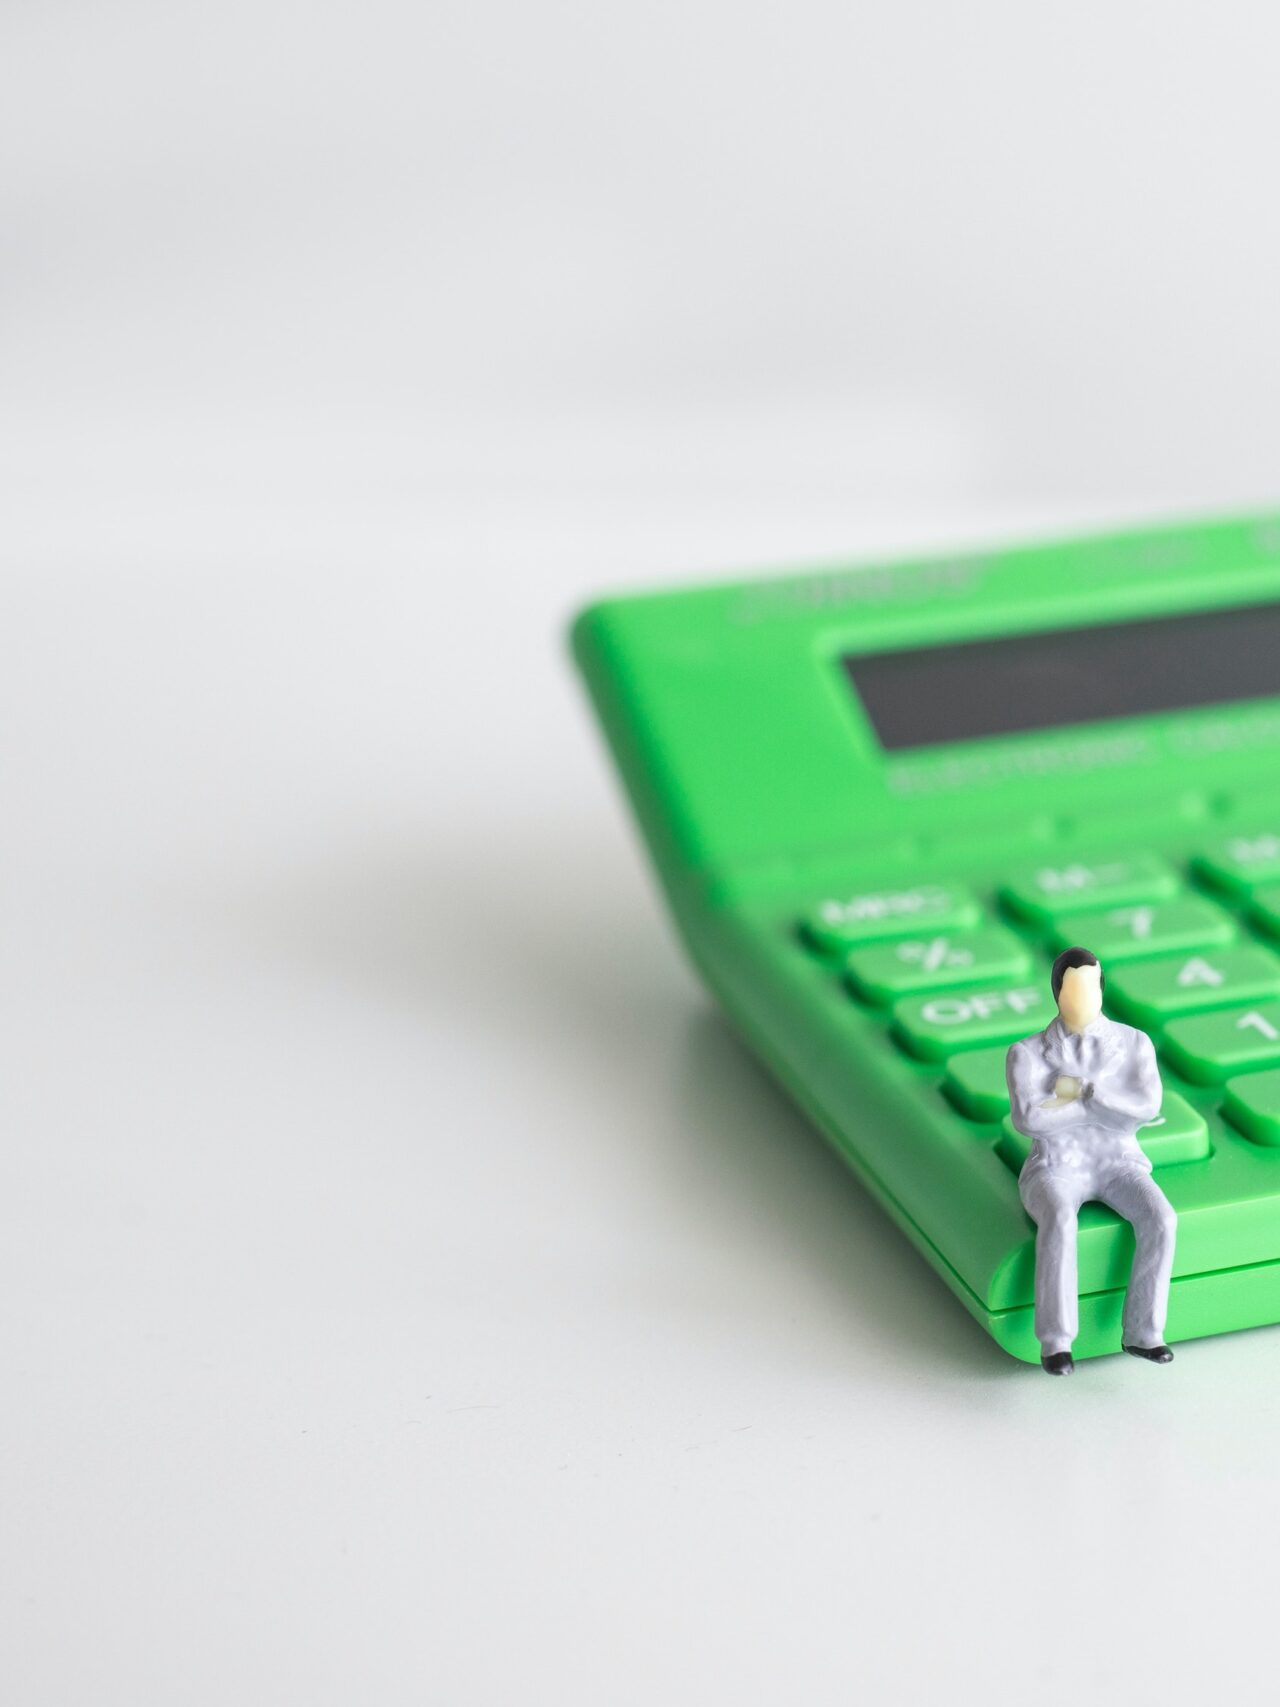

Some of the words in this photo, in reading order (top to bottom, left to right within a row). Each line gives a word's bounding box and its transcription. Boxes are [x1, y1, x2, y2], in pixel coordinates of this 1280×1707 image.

[1108, 905, 1153, 941] 7
[897, 938, 974, 974] %
[1177, 957, 1226, 988] 4
[921, 987, 1041, 1025] OFF
[1236, 1011, 1280, 1041] 1
